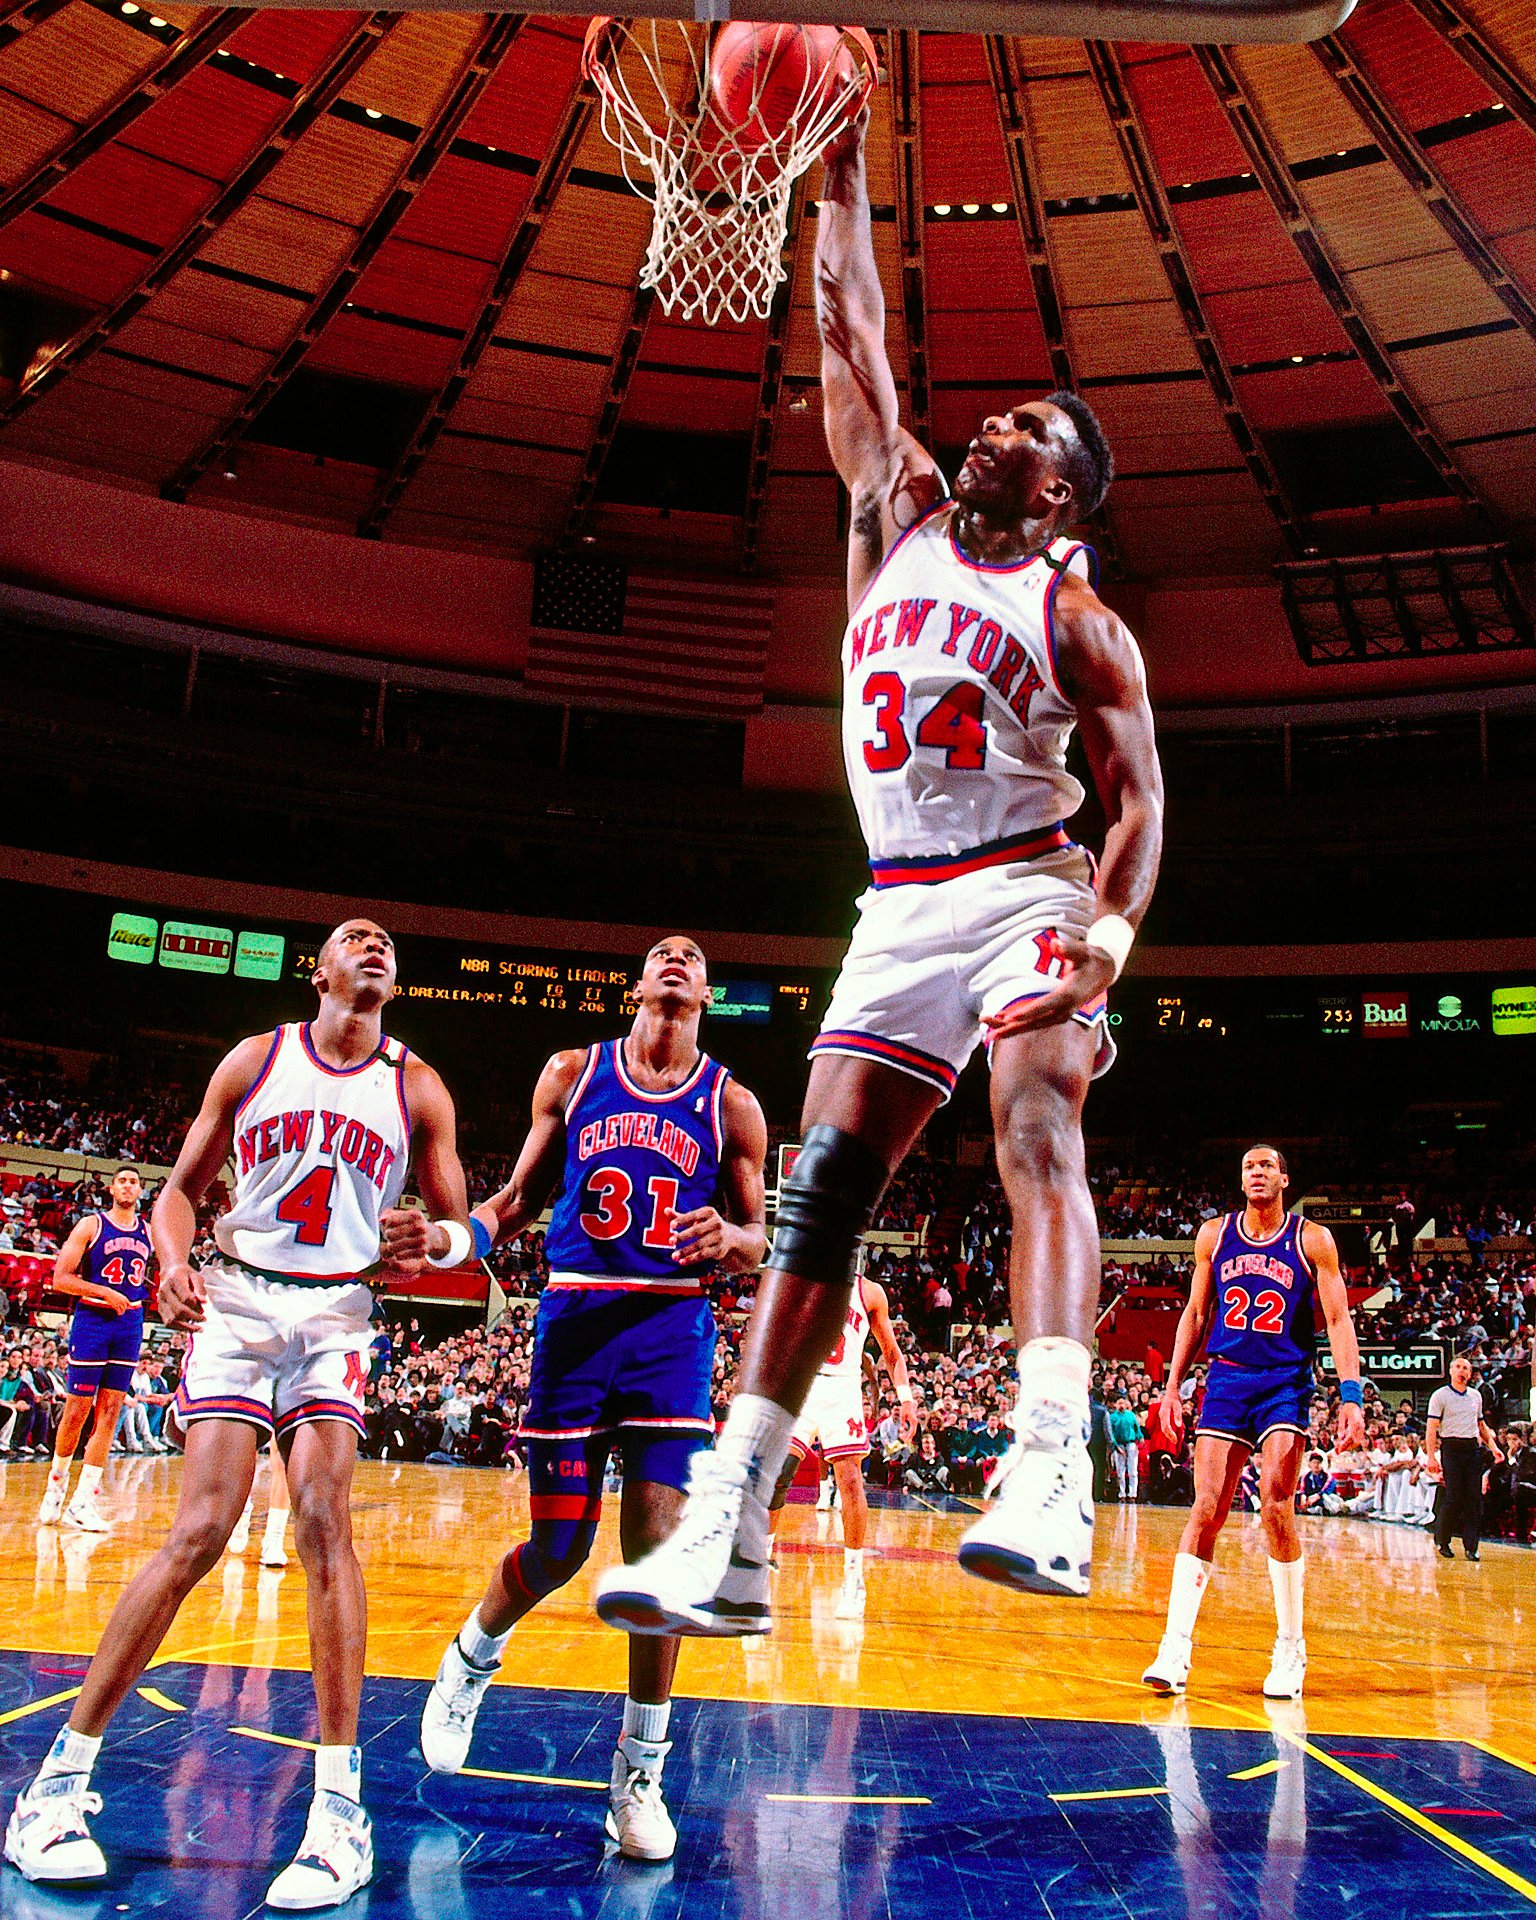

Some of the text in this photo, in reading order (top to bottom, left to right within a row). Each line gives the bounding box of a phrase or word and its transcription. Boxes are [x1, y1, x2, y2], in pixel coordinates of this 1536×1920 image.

[849, 598, 1046, 730] NEW YORK
[862, 671, 988, 773] 34
[111, 928, 156, 948] Hertz
[164, 936, 229, 957] LOTTO
[460, 958, 627, 985] NBA SCORING LEADERS
[510, 996, 527, 1005] 44
[579, 1001, 605, 1013] 206
[799, 996, 808, 1010] 3
[1363, 1002, 1407, 1023] Bud
[1158, 1009, 1185, 1026] 21
[1420, 1018, 1480, 1032] MINOLTA
[238, 1109, 395, 1192] NEW YORK
[579, 1111, 700, 1177] CLEVELAND
[276, 1164, 336, 1247] 4
[579, 1166, 679, 1250] 31
[1312, 1207, 1348, 1218] GATE
[101, 1256, 145, 1287] 43
[1220, 1253, 1294, 1290] CLEVELAND
[1223, 1285, 1286, 1334] 22
[1369, 1354, 1437, 1370] LIGHT
[325, 1796, 359, 1822] PONY
